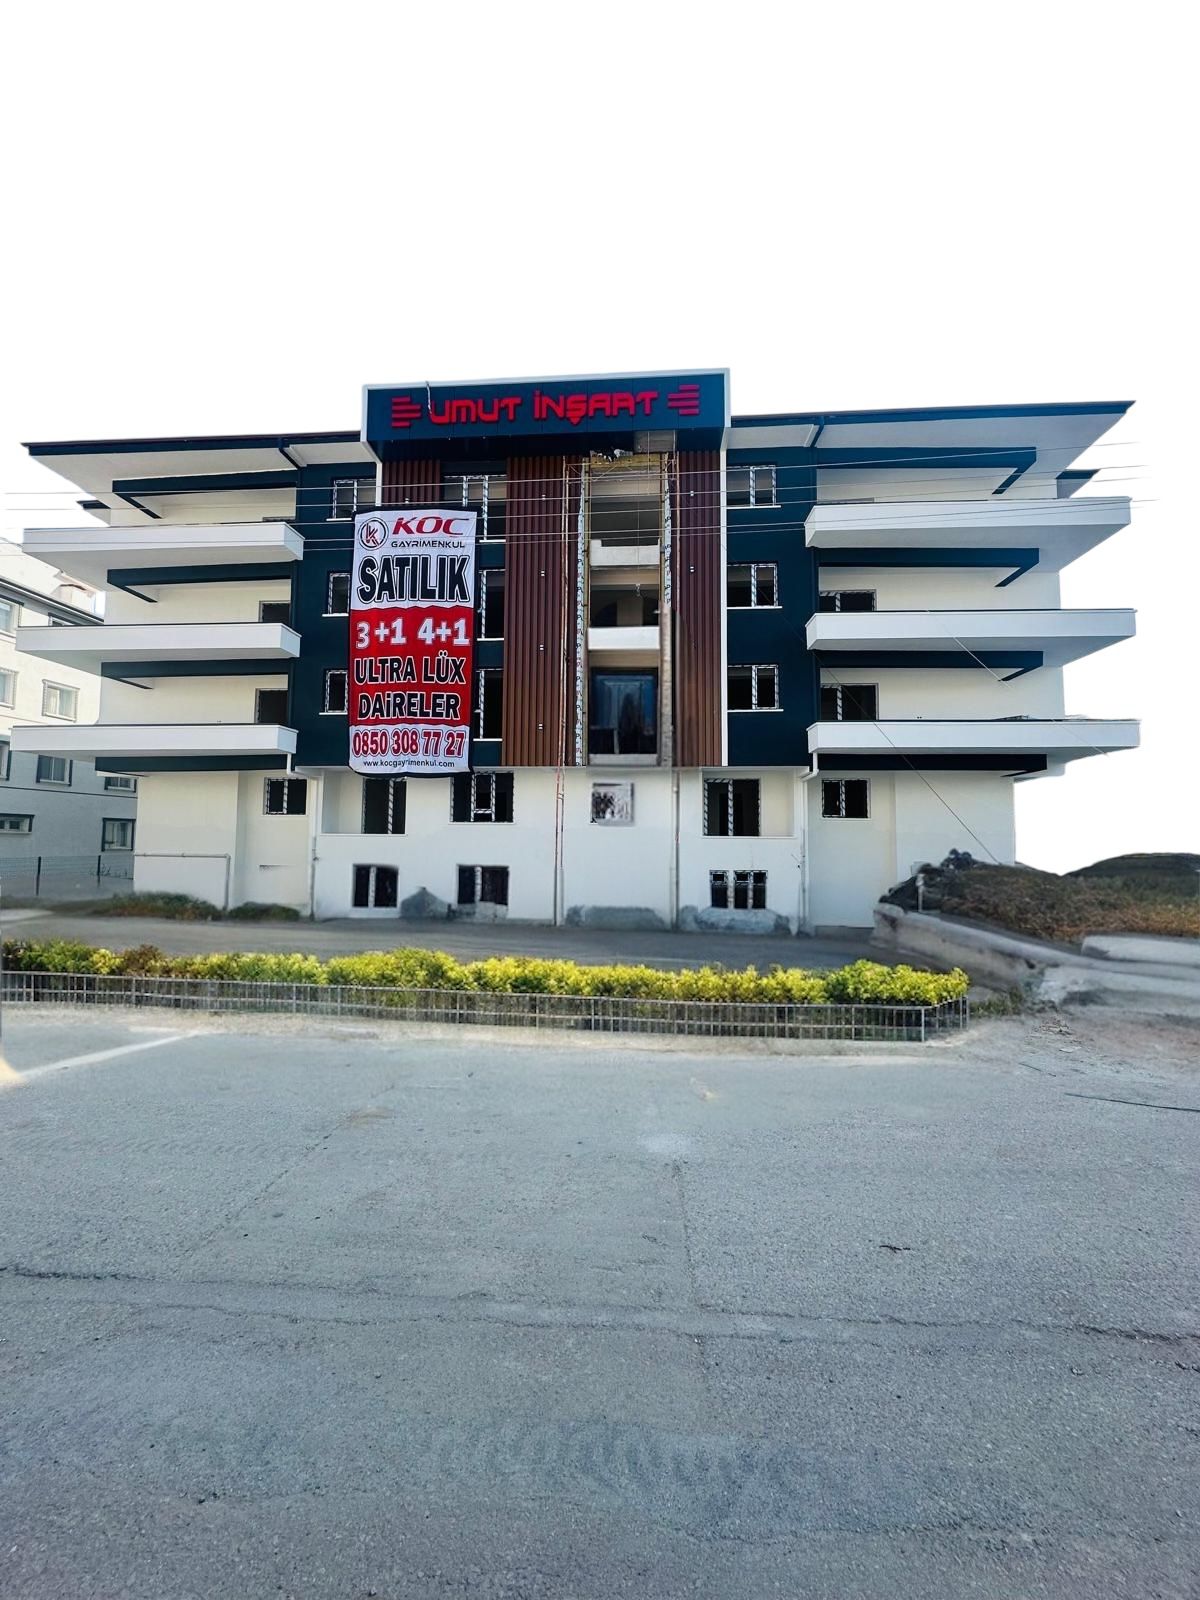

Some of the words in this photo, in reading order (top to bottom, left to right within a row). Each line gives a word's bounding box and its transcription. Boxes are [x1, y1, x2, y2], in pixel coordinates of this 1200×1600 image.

[430, 397, 523, 424] UMUT
[357, 554, 471, 605] SATILIK
[356, 617, 407, 650] 3+1
[417, 617, 471, 647] 4+1
[354, 656, 418, 685] ULTRA
[422, 650, 467, 685] LÜX
[352, 729, 390, 757] 0850
[391, 728, 420, 756] 308
[420, 730, 443, 756] 77
[444, 730, 466, 758] 27
